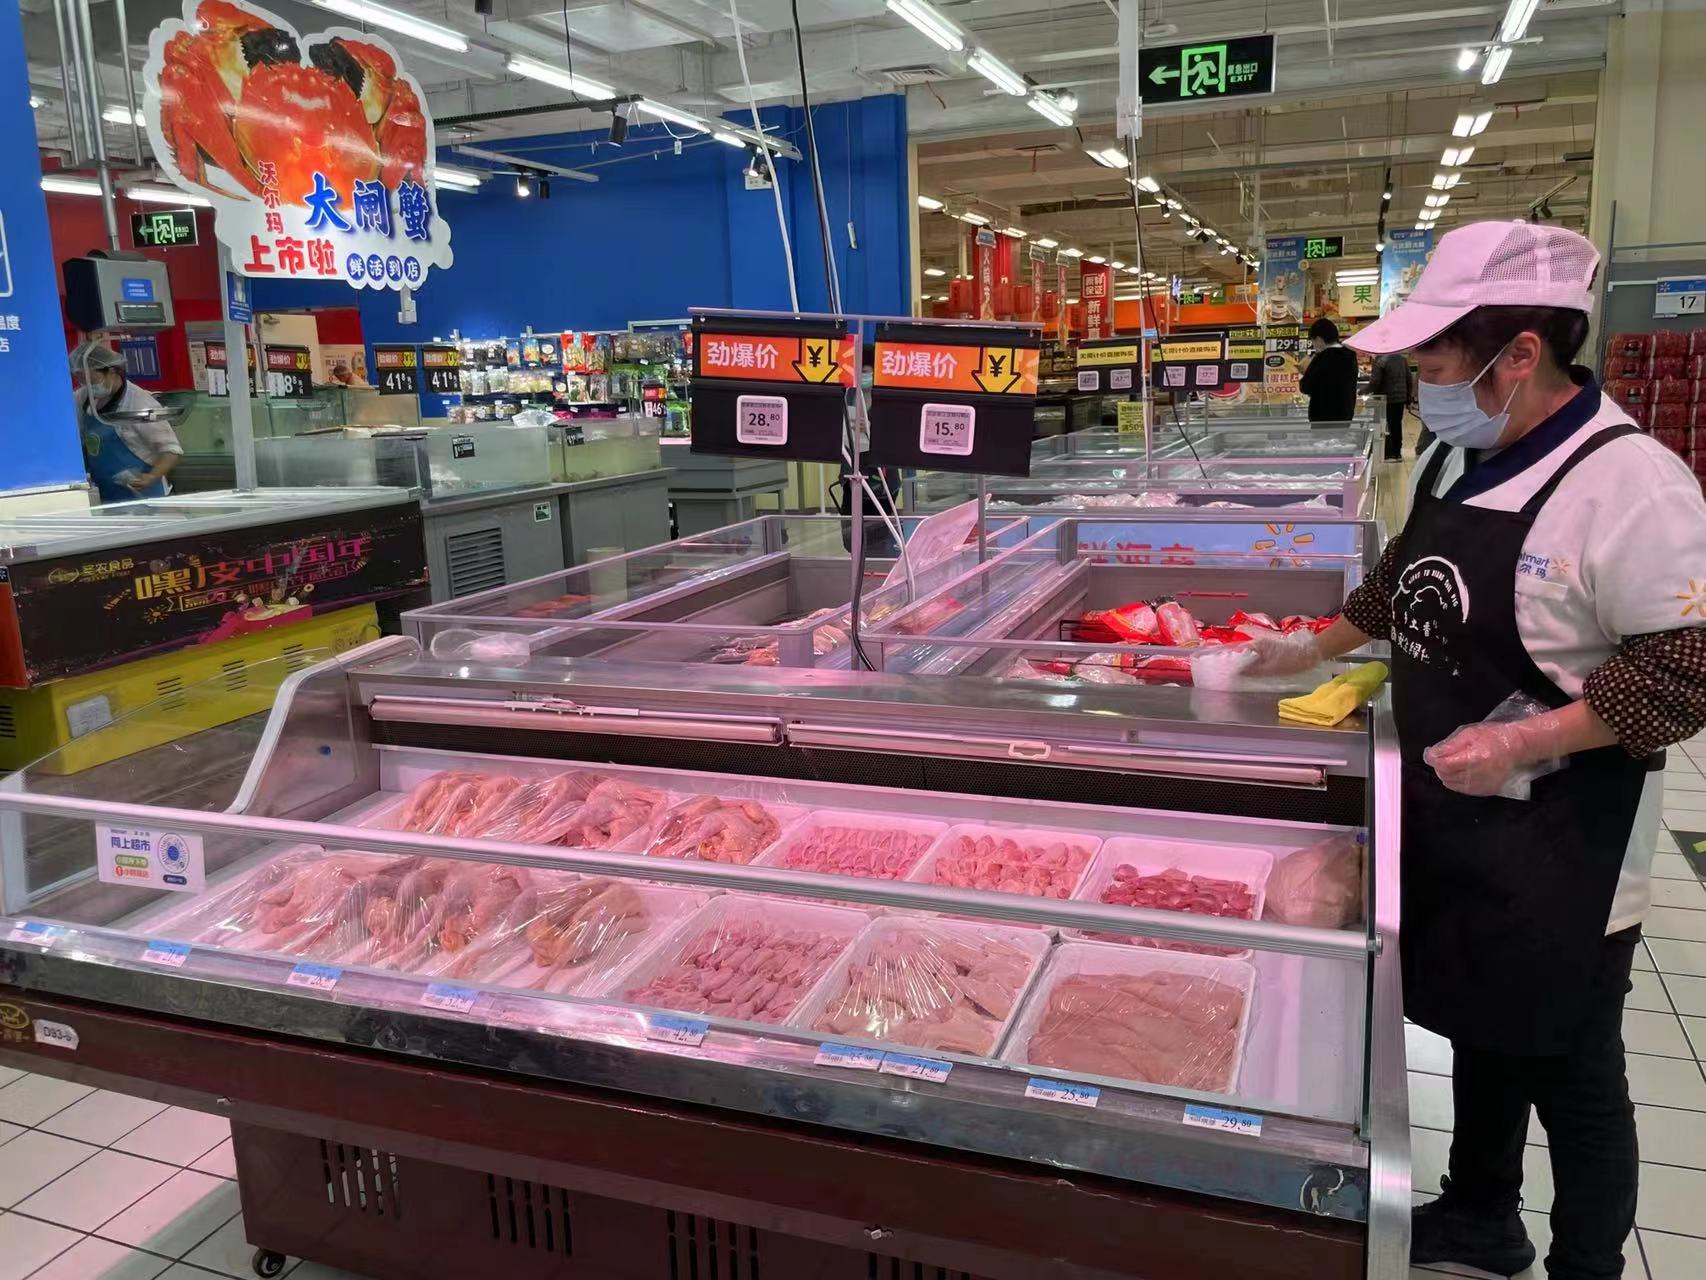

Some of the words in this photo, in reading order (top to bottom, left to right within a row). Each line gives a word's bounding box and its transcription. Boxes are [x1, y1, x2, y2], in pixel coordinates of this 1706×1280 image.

[1230, 74, 1254, 83] EXIT
[259, 160, 284, 234] 沃尔玛
[304, 172, 429, 240] 大闸蟹
[244, 234, 338, 276] 上市啦
[348, 256, 419, 279] 鲜活到店
[1680, 296, 1697, 309] 17
[707, 341, 779, 369] 劲爆价
[882, 350, 958, 379] 劲爆价
[748, 412, 780, 428] 28.80
[935, 422, 965, 436] 15.80
[1518, 562, 1547, 579] 尔玛
[1060, 1088, 1089, 1102] 25.80
[1221, 1115, 1252, 1130] 29.80
